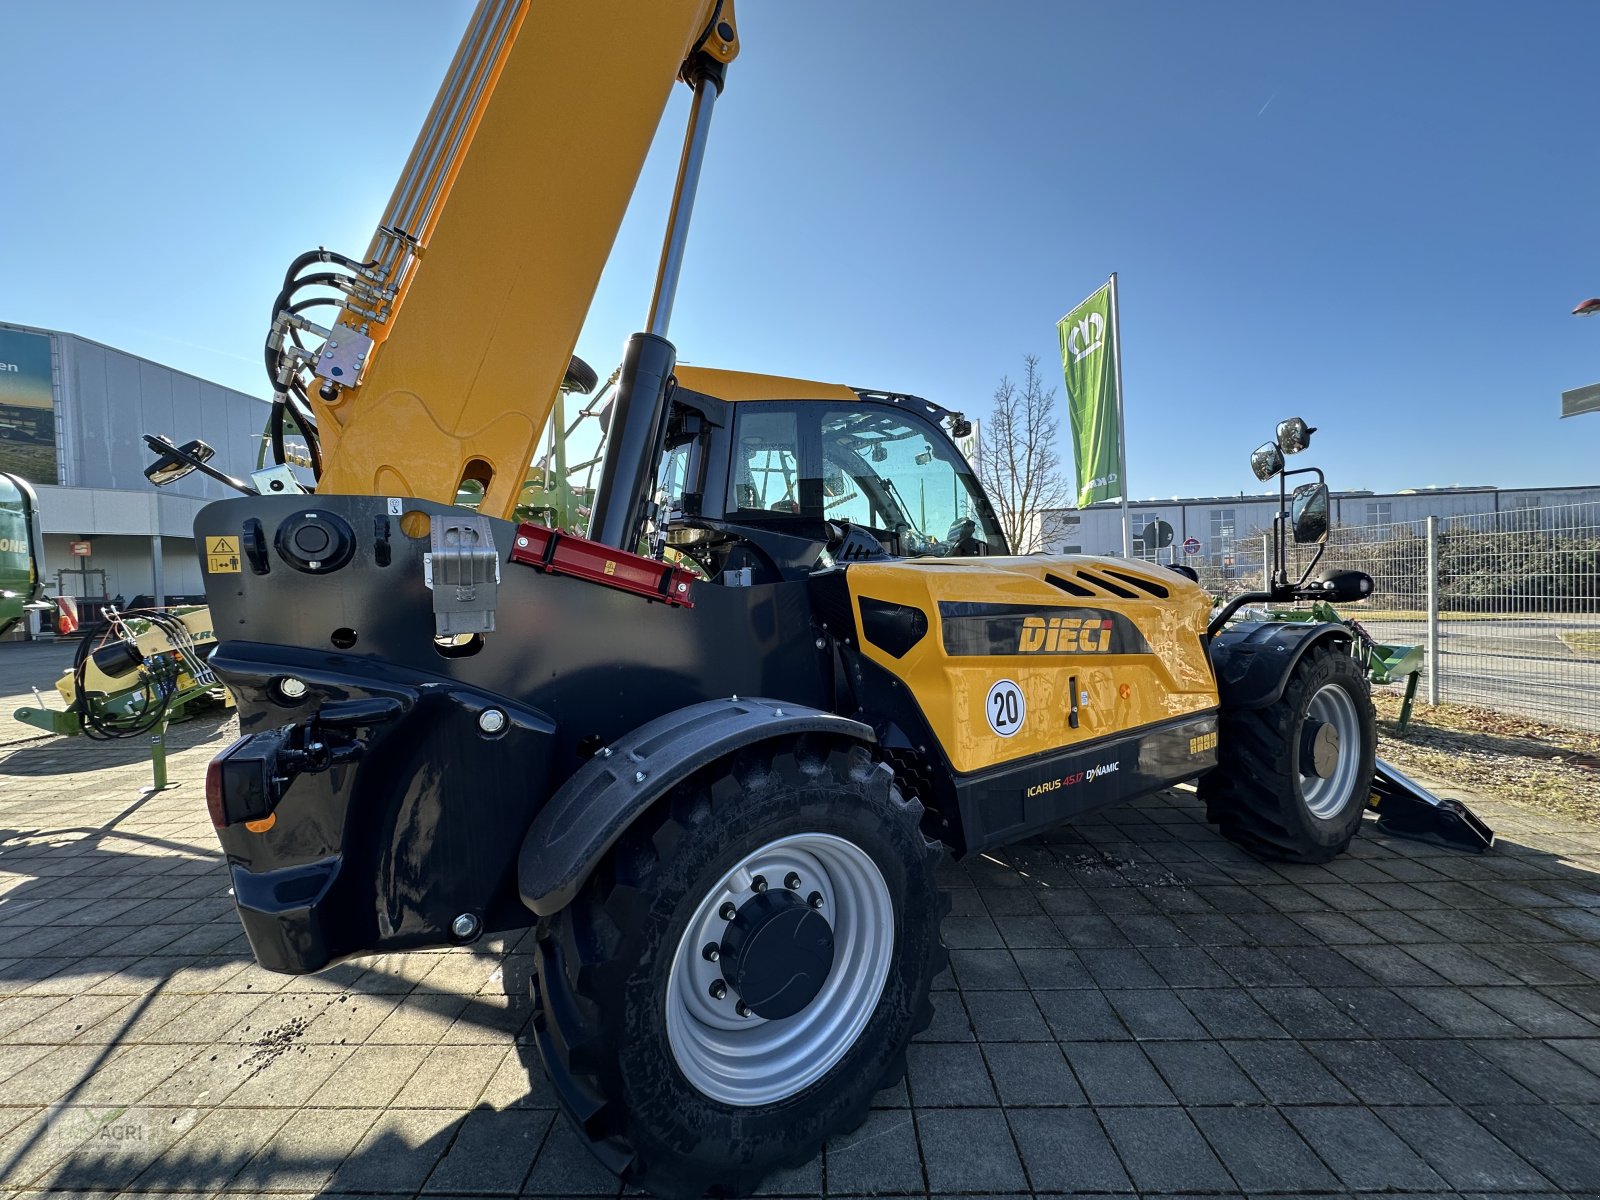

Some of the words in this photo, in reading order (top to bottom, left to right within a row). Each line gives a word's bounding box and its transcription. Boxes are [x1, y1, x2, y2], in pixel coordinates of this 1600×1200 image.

[1018, 617, 1113, 652] DIECI
[993, 690, 1019, 727] 20
[1027, 778, 1061, 798] ICARUS
[1085, 761, 1120, 783] DYNAMIC
